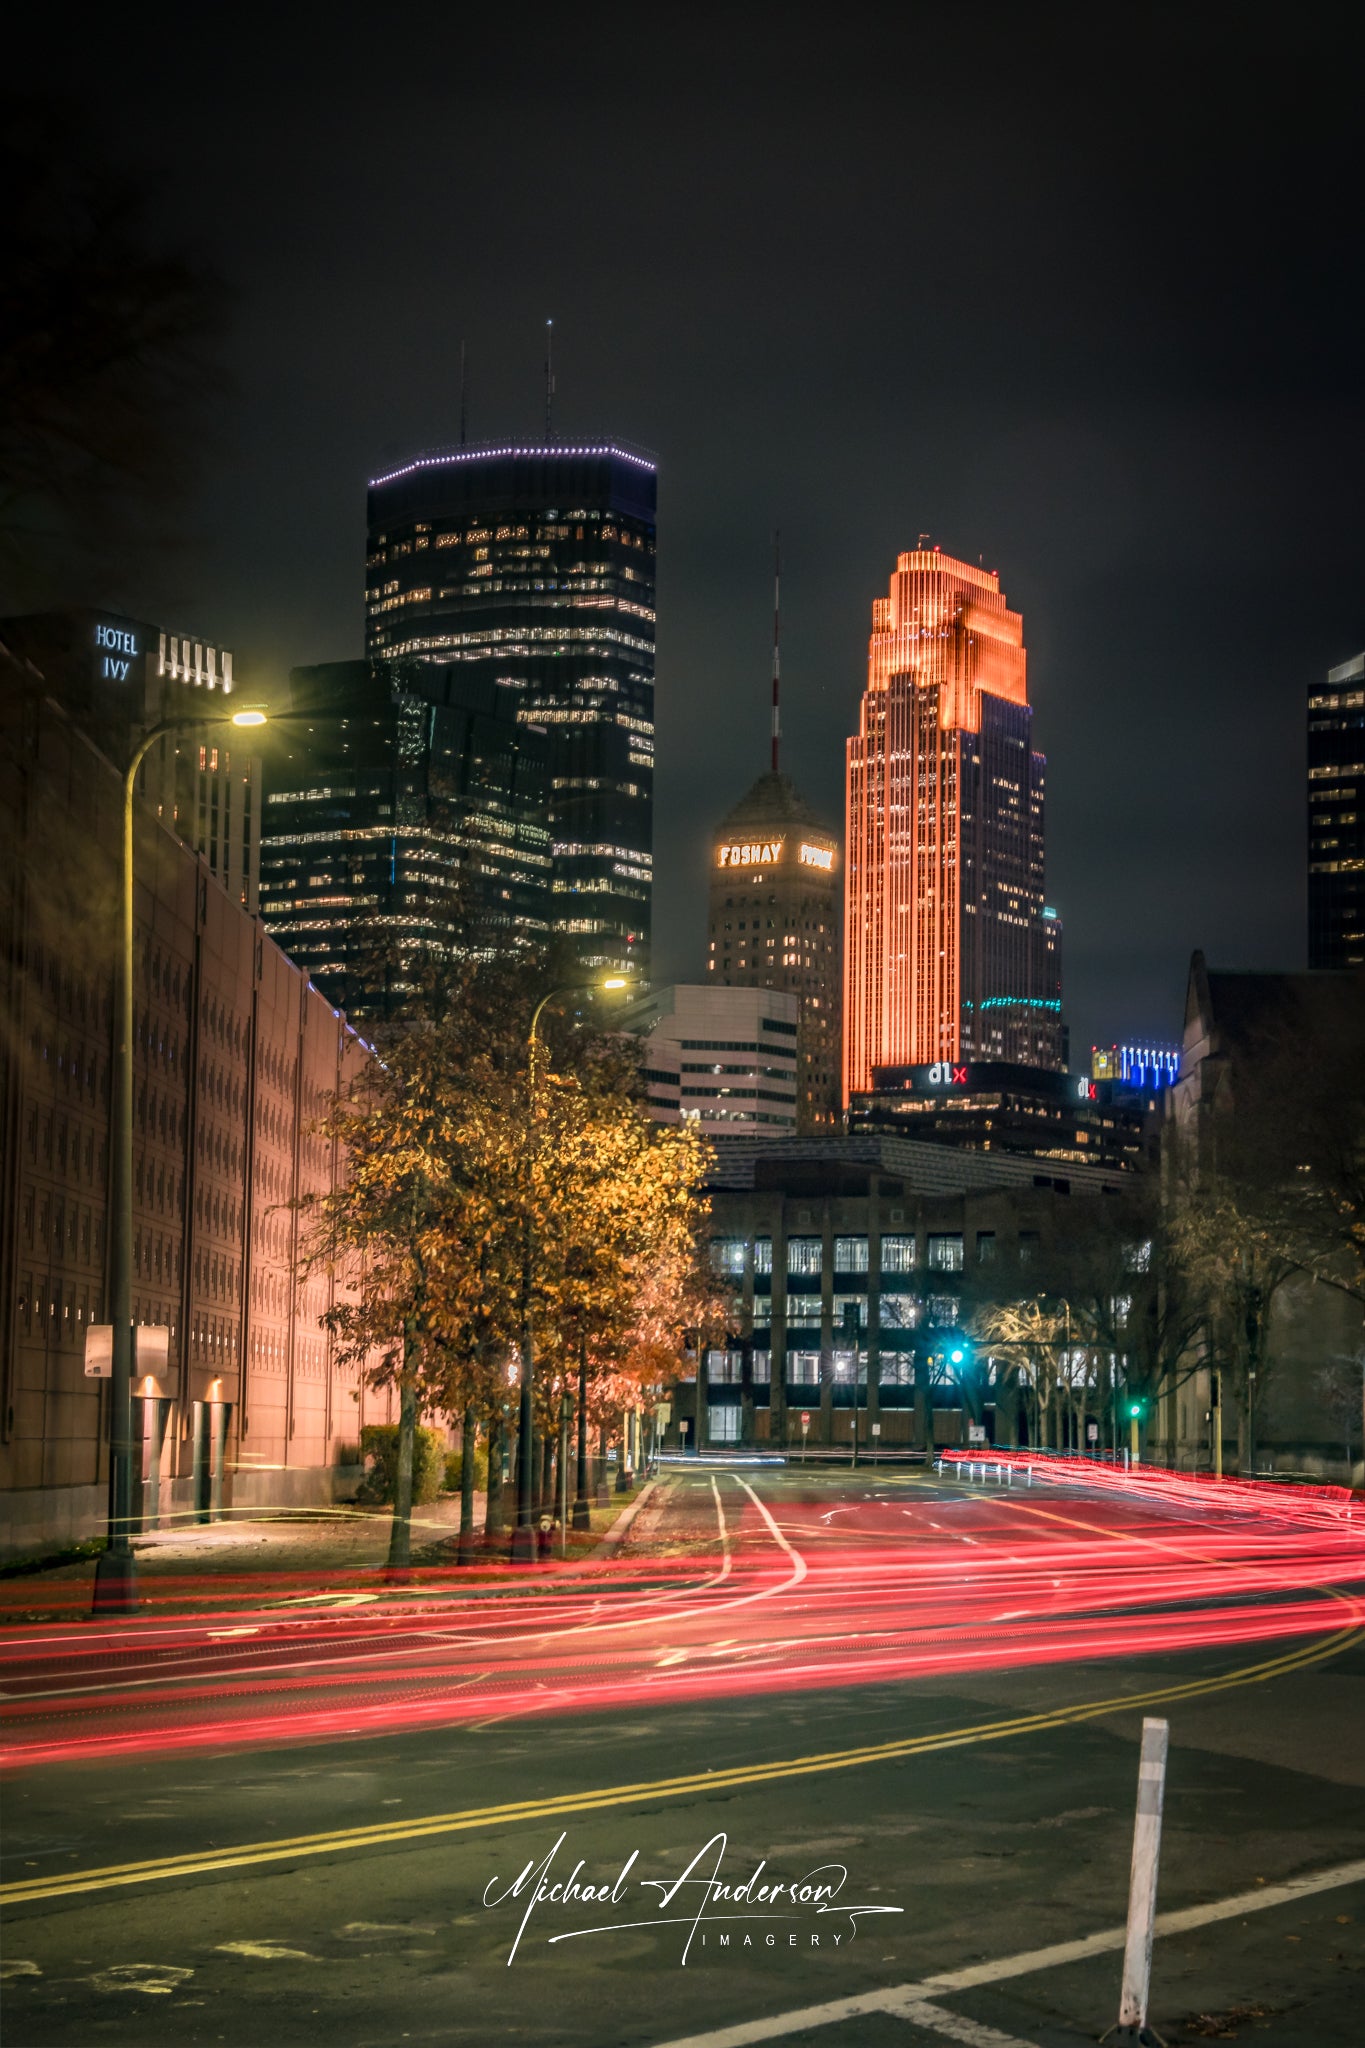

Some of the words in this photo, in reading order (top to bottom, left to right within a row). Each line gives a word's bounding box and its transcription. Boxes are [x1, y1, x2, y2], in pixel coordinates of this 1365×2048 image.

[96, 625, 138, 655] HOTEL
[103, 657, 130, 681] IVY
[720, 843, 781, 866] FOSHAY
